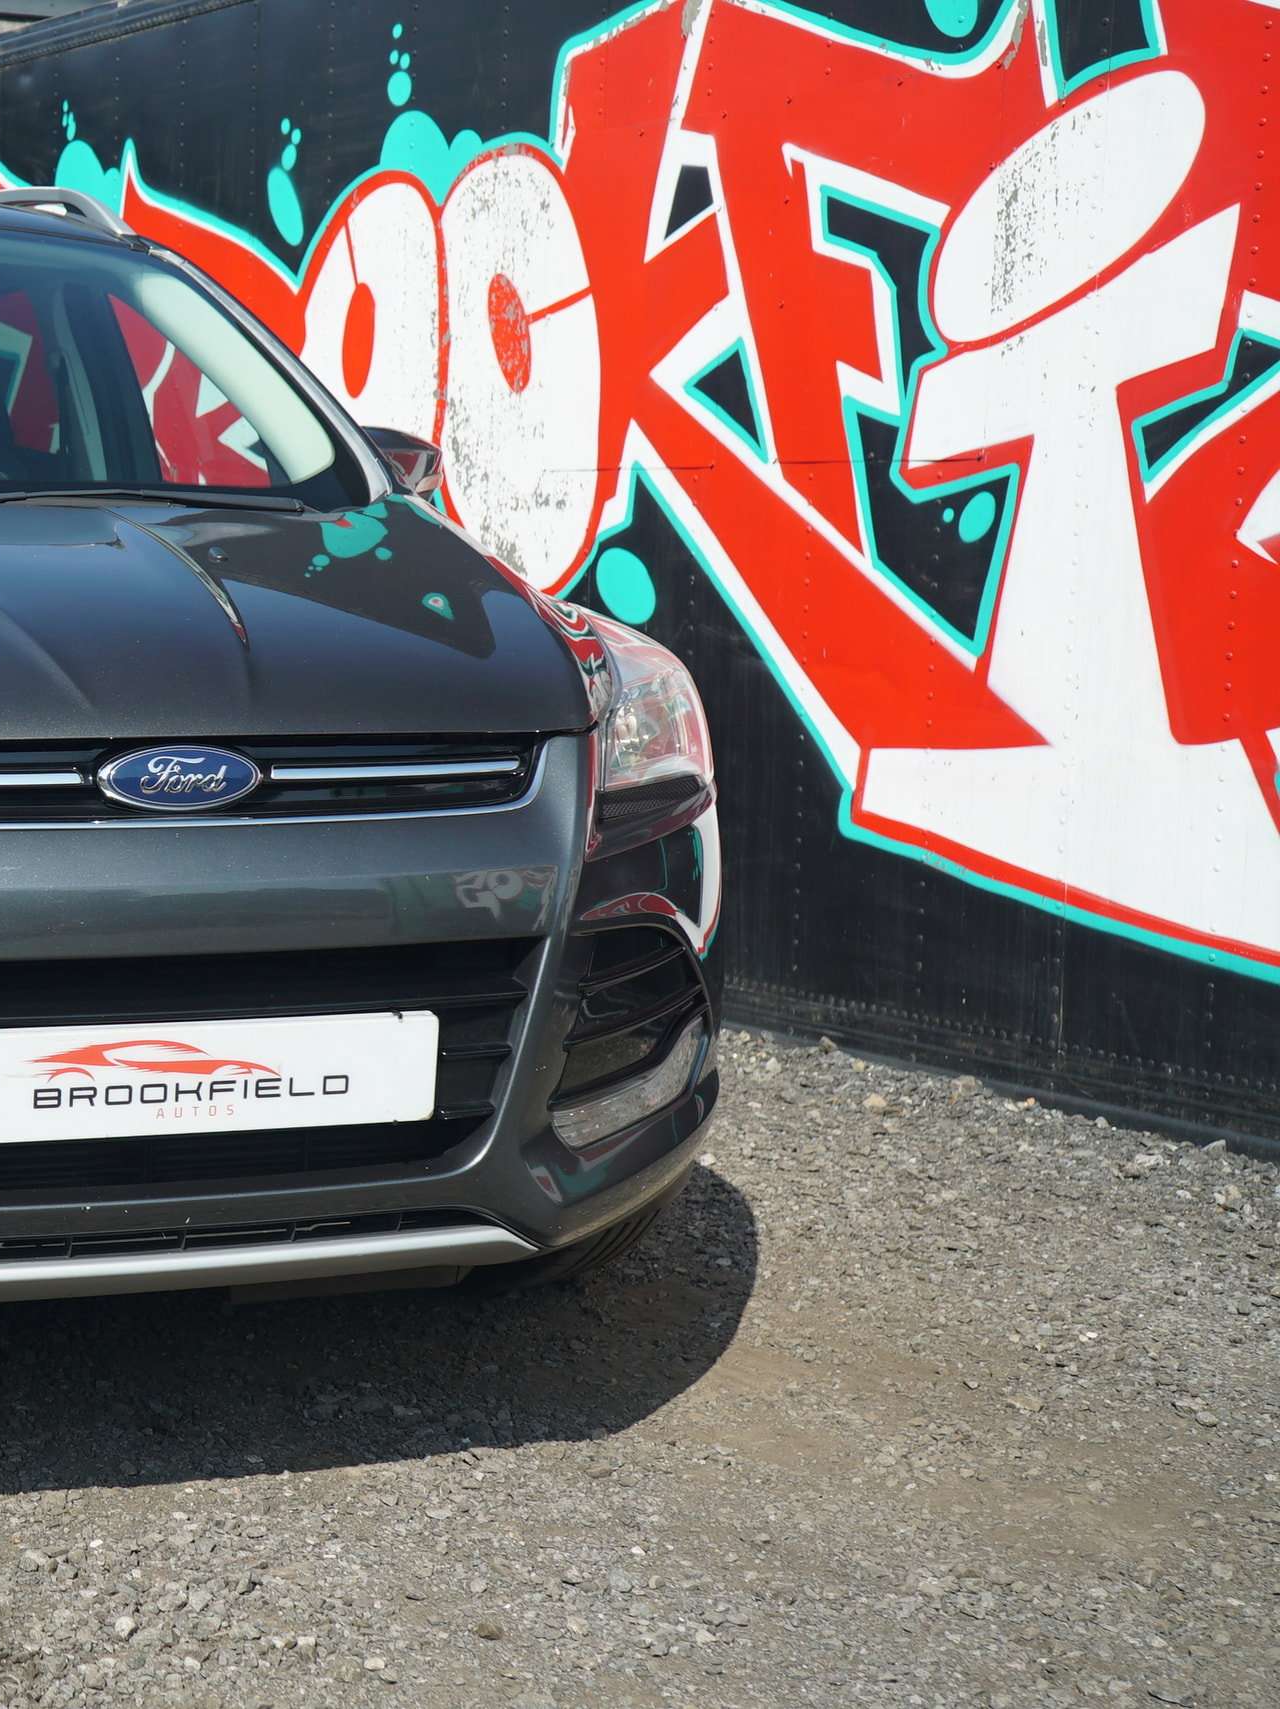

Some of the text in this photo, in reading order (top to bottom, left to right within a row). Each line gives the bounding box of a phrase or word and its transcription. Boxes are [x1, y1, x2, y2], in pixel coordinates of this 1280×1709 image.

[140, 756, 227, 794] Ford
[33, 1075, 350, 1109] BROOKFIELD
[156, 1105, 235, 1119] AUTOS
